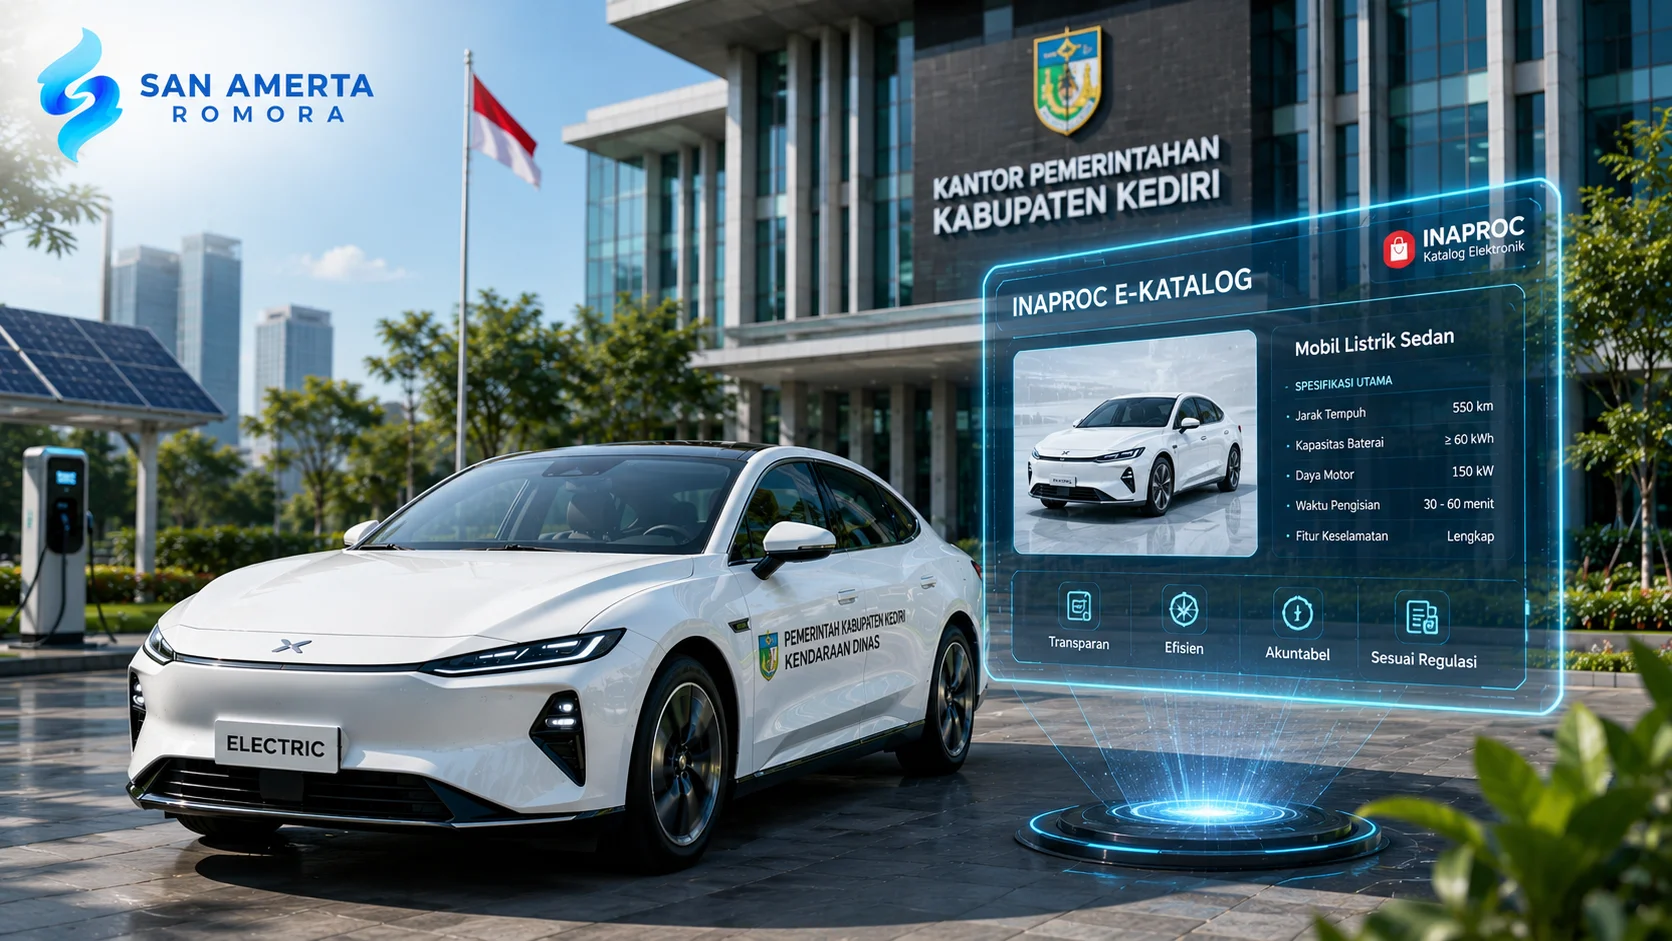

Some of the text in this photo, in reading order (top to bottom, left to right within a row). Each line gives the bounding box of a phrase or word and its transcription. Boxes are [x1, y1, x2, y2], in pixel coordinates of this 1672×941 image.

[933, 135, 1220, 200] KANTOR PEMERINTAHAN
[933, 169, 1220, 235] KABUPATEN KEDIRI
[1423, 215, 1526, 247] INAPROC
[1423, 239, 1526, 265] Katalog Elektronik
[1012, 267, 1253, 317] INAPROC E-KATALOG
[1295, 328, 1455, 357] Mobil Listrik Sedan
[1295, 375, 1393, 392] SPESIFIKASI UTAMA
[1295, 407, 1367, 422] Jarak Tempuh
[1452, 400, 1494, 413] 550 km
[1295, 436, 1384, 453] Kapasitas Baterai
[1454, 434, 1468, 445] 60
[1471, 433, 1494, 444] kWh
[1295, 469, 1355, 484] Daya Motor
[1452, 465, 1494, 477] 150 kW
[1296, 499, 1381, 513] Waktu Pengisian
[1423, 499, 1438, 510] 30
[1447, 498, 1461, 509] 60
[1463, 498, 1494, 510] menit
[1296, 530, 1389, 542] Fitur Keselamatan
[1447, 530, 1495, 544] Lengkap
[784, 621, 840, 647] PEMERINTAH
[842, 613, 884, 635] KABUPATEN
[785, 634, 881, 670] KENDARAAN DINAS
[1048, 635, 1110, 653] Transparan
[1164, 641, 1204, 656] Efisien
[1265, 644, 1331, 662] Akuntabel
[1371, 650, 1478, 672] Sesuai Regulasi
[227, 735, 325, 758] ELECTRIC
